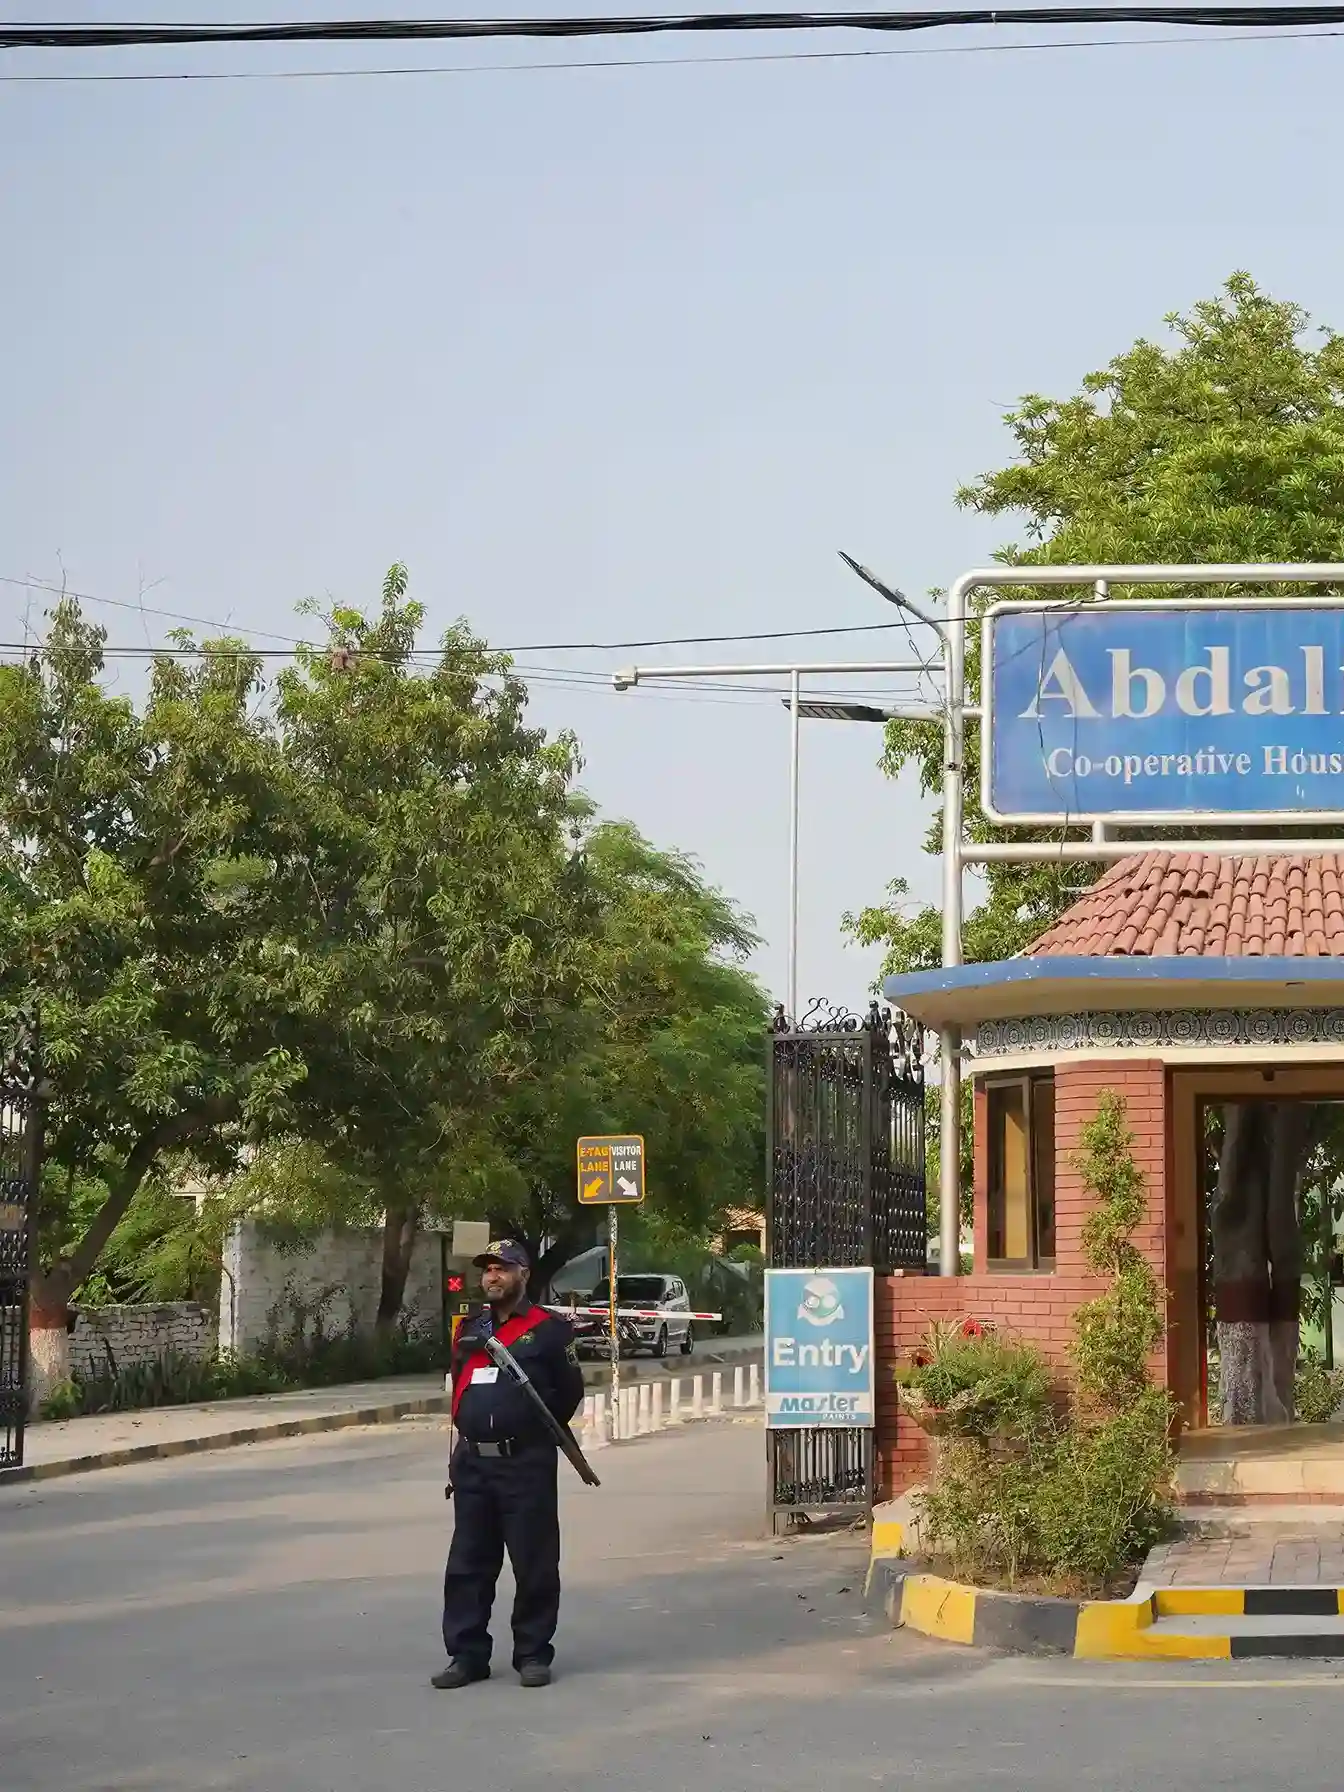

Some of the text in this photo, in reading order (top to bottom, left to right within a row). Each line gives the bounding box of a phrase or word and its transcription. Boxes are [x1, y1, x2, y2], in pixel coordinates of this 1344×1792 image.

[1048, 746, 1251, 785] Co-operative
[611, 1145, 641, 1156] VISITOR
[580, 1161, 609, 1172] LANE
[614, 1160, 637, 1171] LANE
[773, 1337, 868, 1374] Entry
